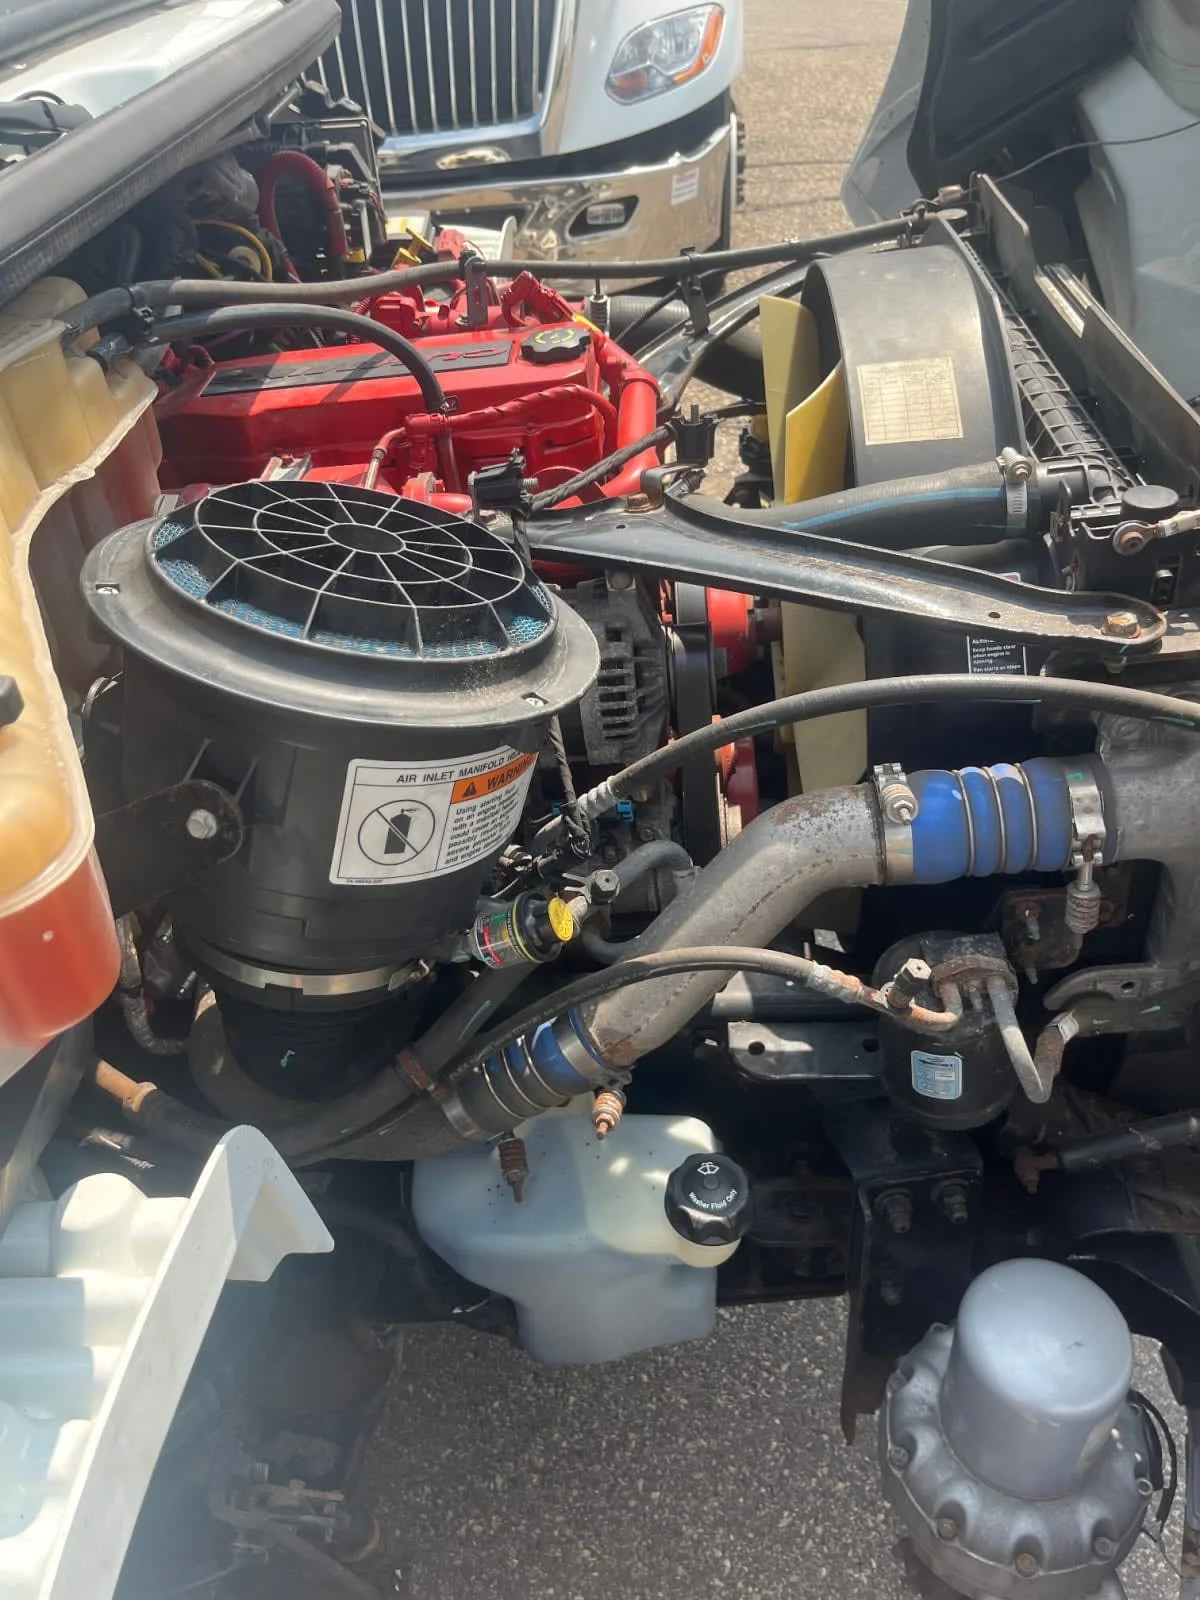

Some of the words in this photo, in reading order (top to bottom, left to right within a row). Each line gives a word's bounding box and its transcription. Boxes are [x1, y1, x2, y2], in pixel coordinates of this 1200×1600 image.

[396, 774, 417, 784] AIR
[422, 771, 455, 782] INLET
[459, 757, 505, 777] MANIFOLD
[456, 805, 477, 815] Using
[477, 805, 497, 816] engine
[452, 823, 467, 831] with
[450, 830, 470, 840] could
[448, 835, 477, 849] possibly
[444, 856, 459, 864] and
[460, 847, 481, 859] engine
[446, 845, 470, 856] severe
[689, 1192, 709, 1208] Washer
[710, 1200, 727, 1209] Fluid
[725, 1189, 738, 1202] Only
